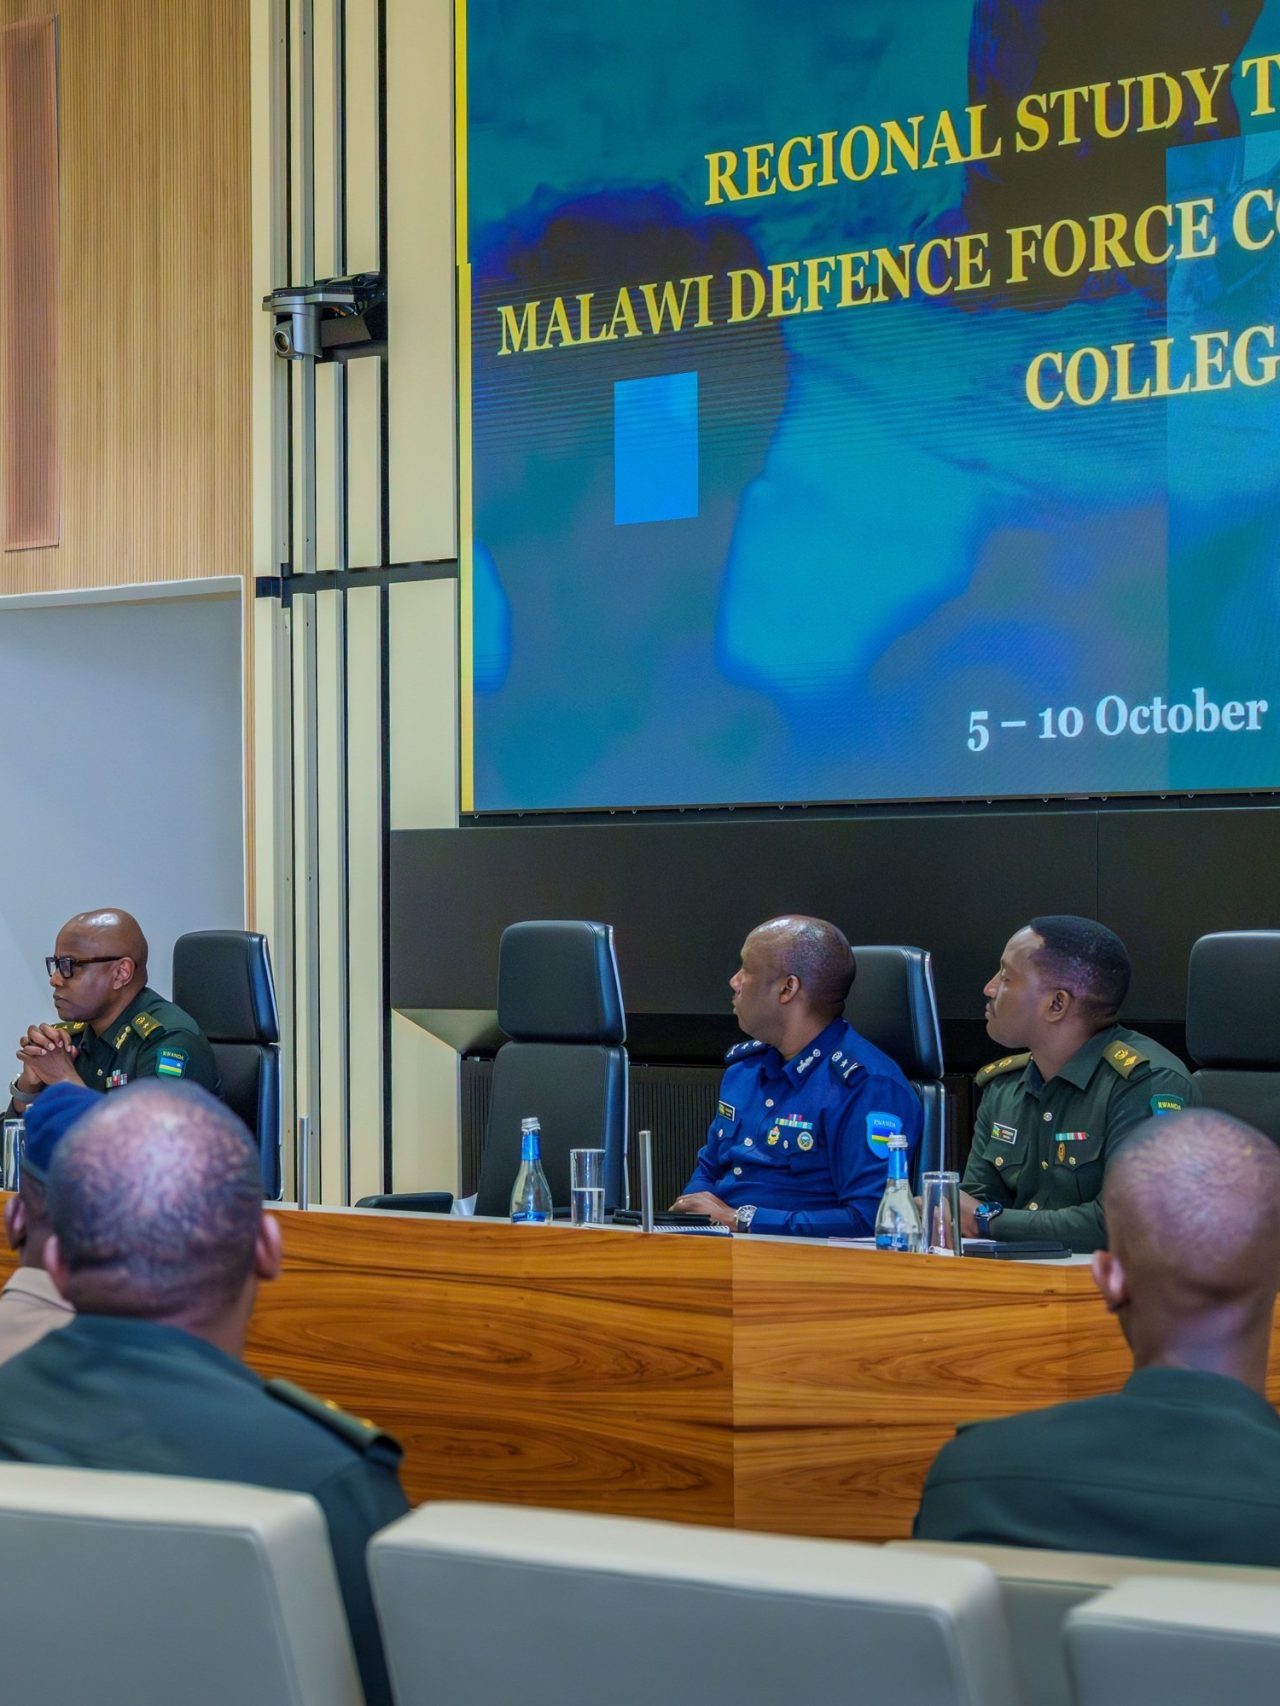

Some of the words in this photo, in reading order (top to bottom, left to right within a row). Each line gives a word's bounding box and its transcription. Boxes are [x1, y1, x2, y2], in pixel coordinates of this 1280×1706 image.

[705, 104, 1002, 206] REGIONAL
[1016, 63, 1230, 153] STUDY
[497, 274, 714, 356] MALAWI
[727, 232, 991, 324] DEFENCE
[1005, 197, 1217, 284] FORCE
[1232, 180, 1280, 251] C
[1026, 325, 1280, 410] COLLEG
[967, 710, 990, 752] 5
[1038, 706, 1084, 739] 10
[1095, 687, 1269, 736] October
